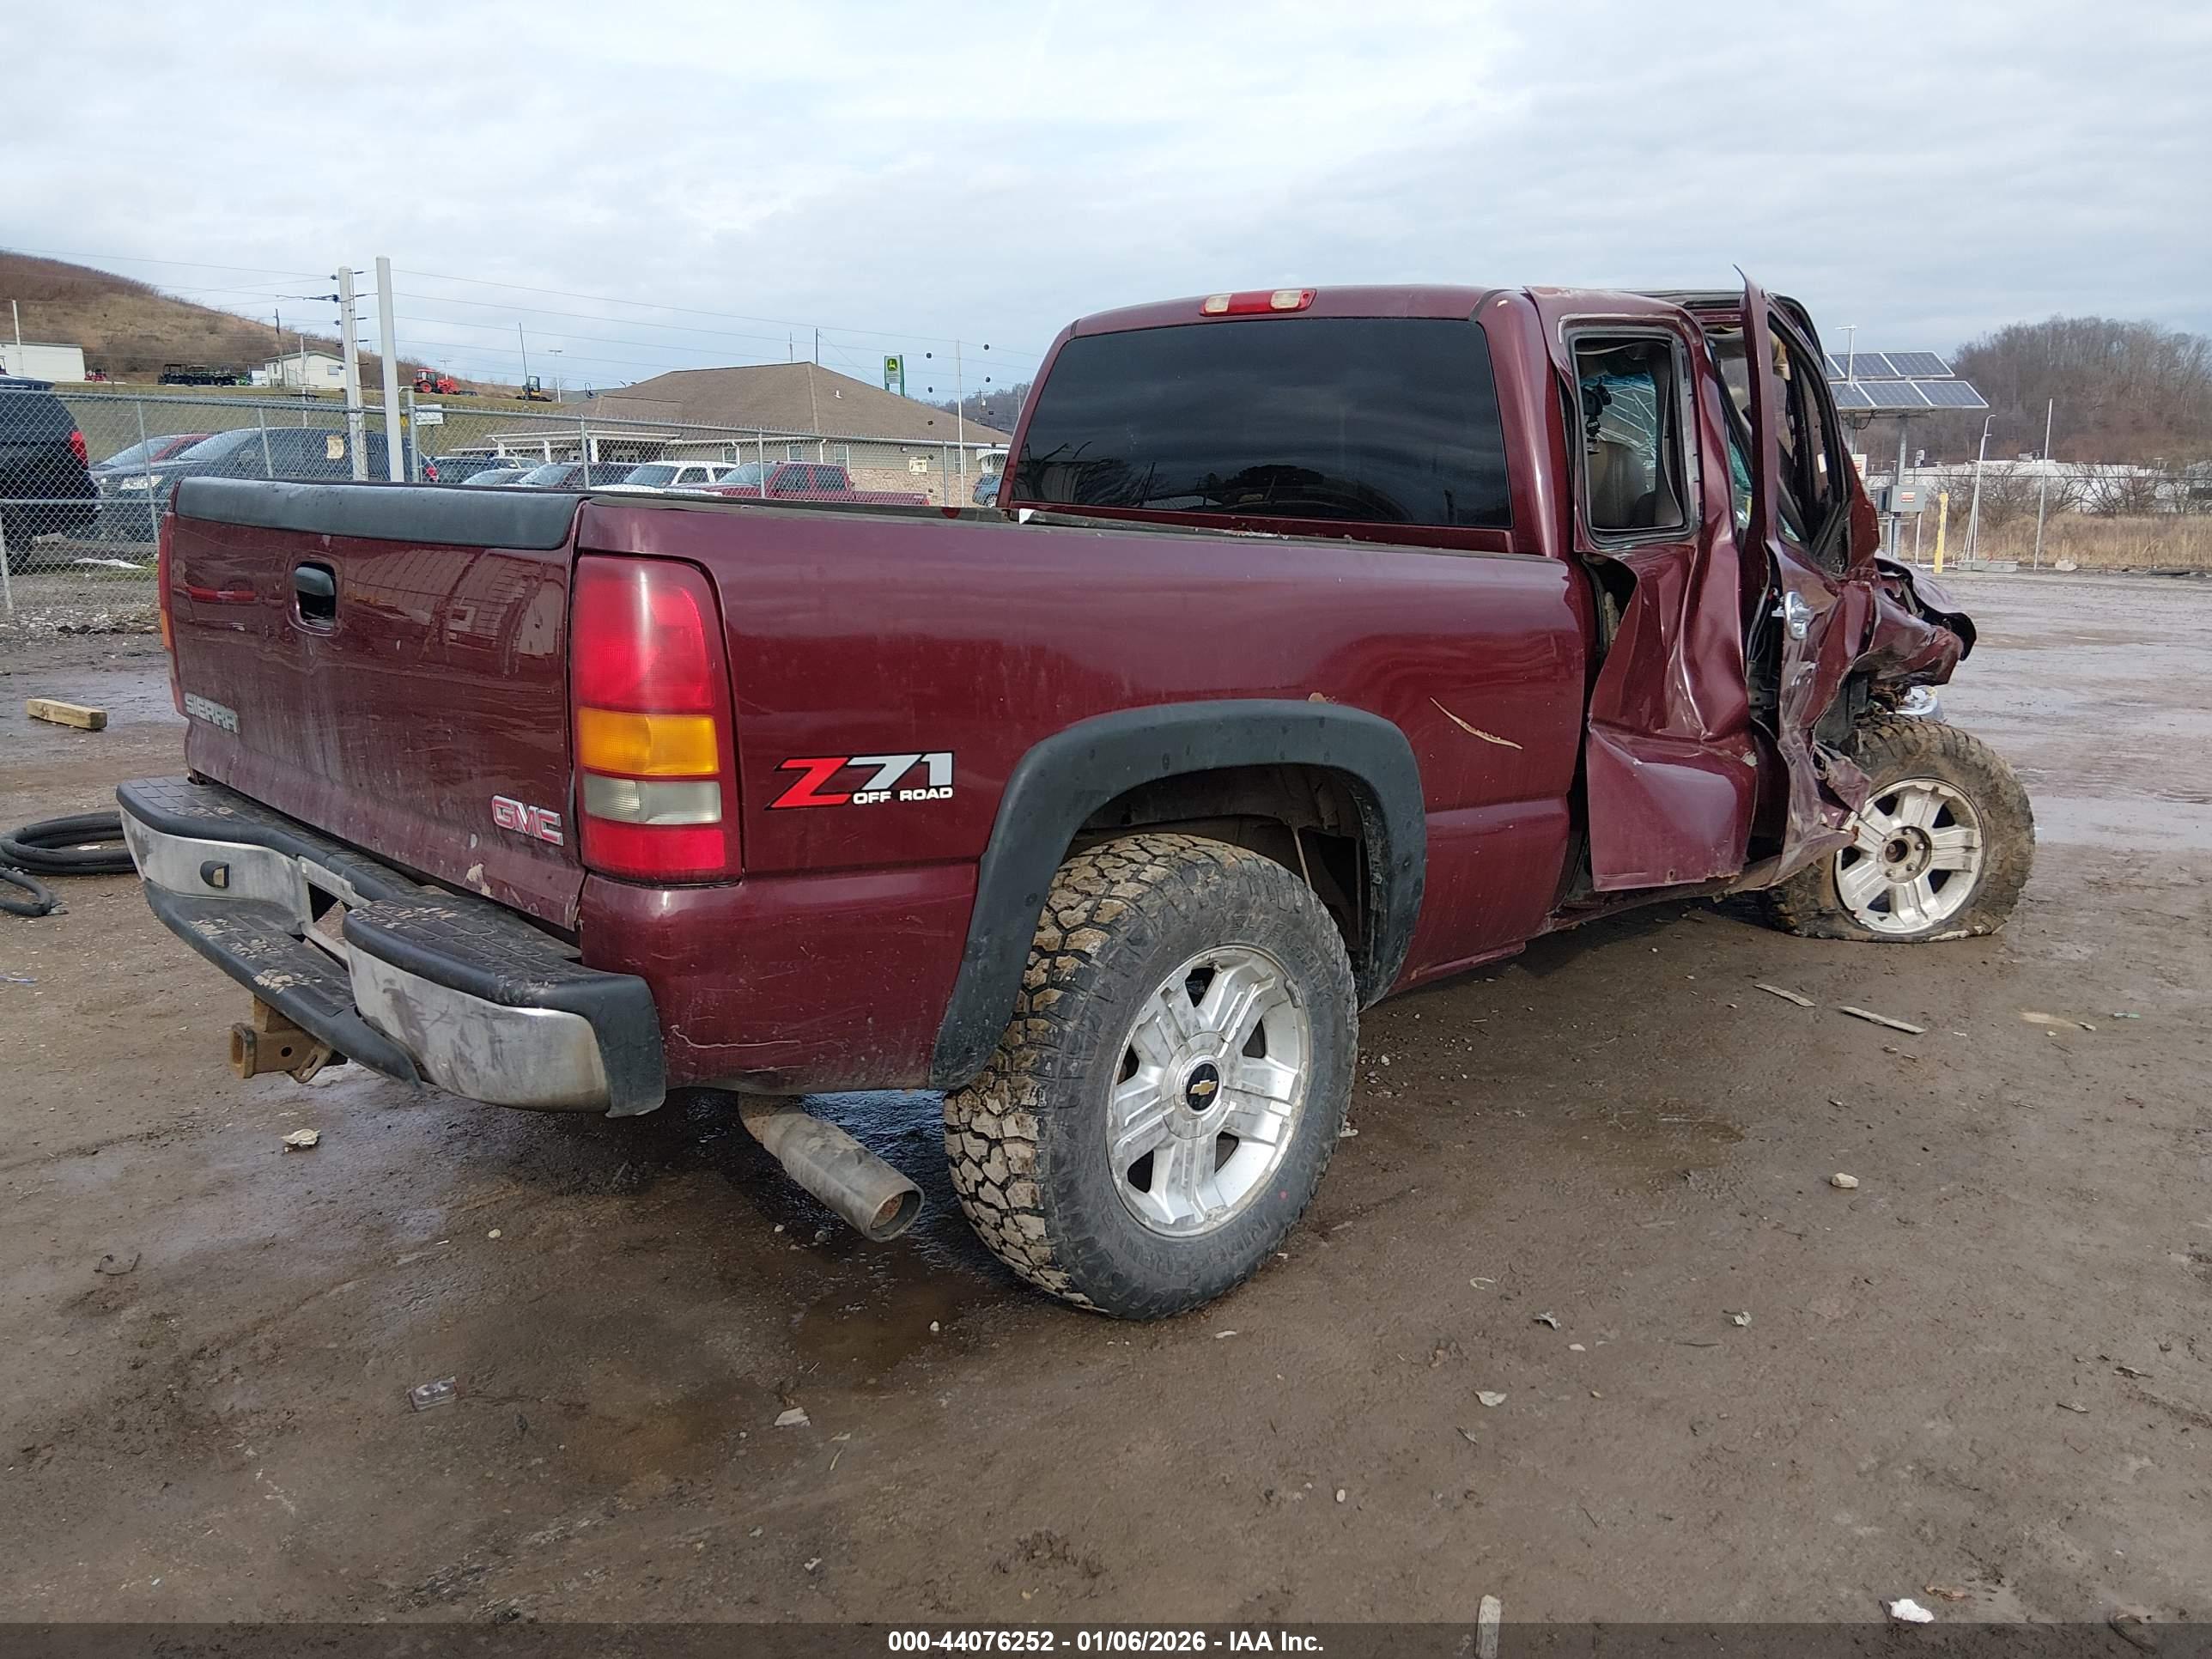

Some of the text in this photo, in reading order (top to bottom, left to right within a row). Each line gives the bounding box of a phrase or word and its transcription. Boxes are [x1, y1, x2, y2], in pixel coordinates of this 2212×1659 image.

[185, 692, 240, 734] SIERRA
[765, 751, 953, 810] Z71
[853, 787, 953, 805] OFF ROAD
[492, 795, 564, 847] GMC
